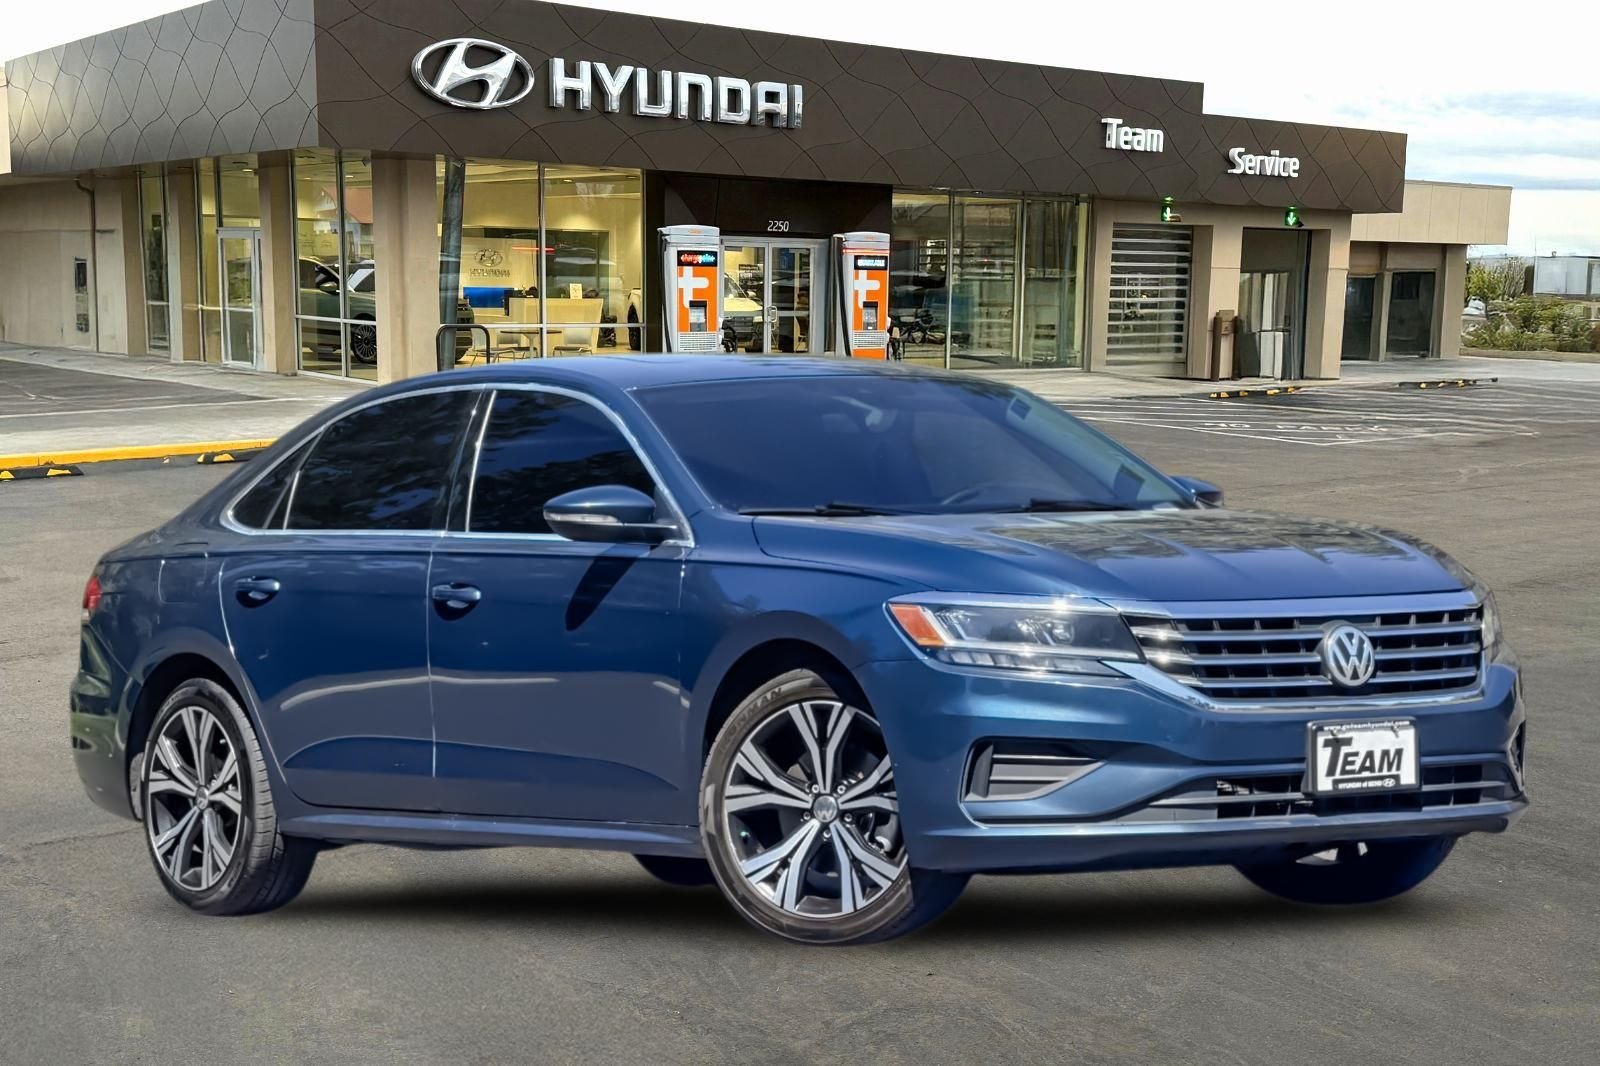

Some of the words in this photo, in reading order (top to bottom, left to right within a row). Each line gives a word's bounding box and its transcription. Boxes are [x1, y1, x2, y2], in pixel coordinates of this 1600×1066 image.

[549, 57, 803, 129] HYUNDAI
[1101, 117, 1164, 153] Team
[1227, 147, 1300, 178] Service
[767, 220, 789, 232] 2250
[1322, 736, 1404, 778] TEAM
